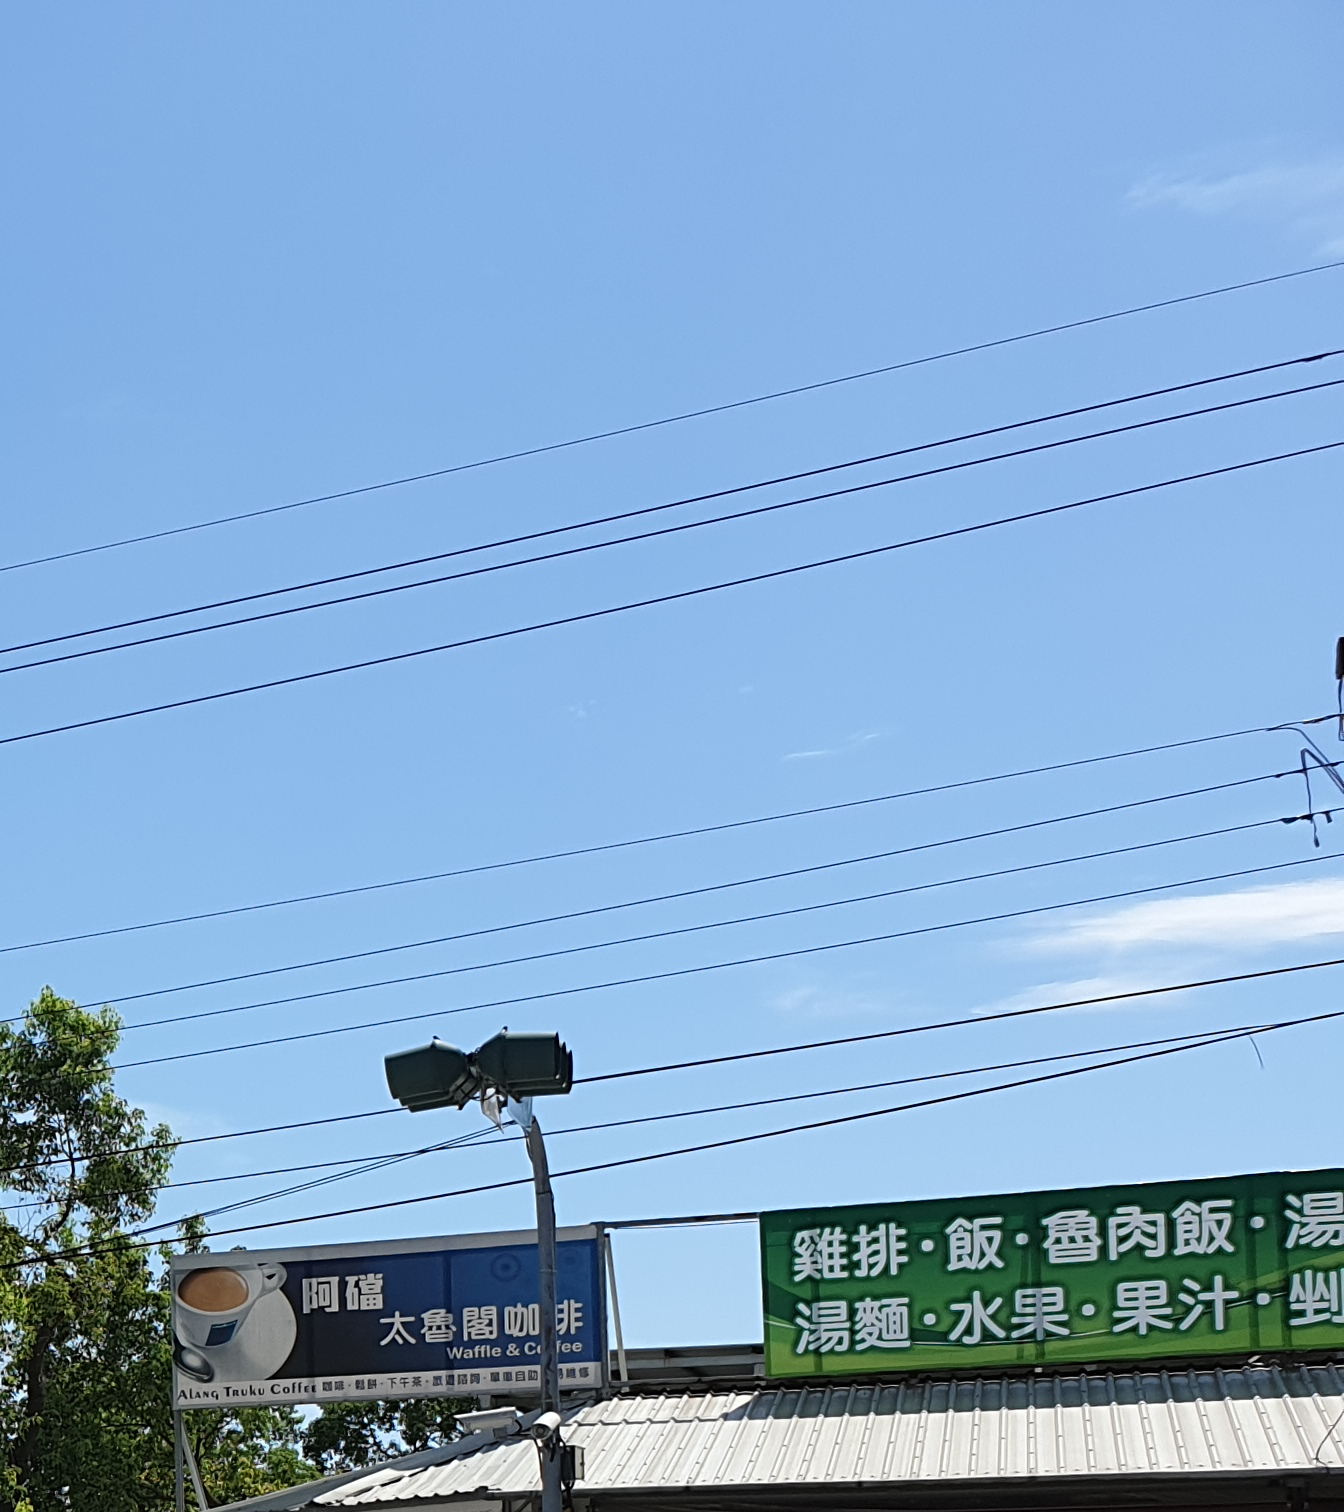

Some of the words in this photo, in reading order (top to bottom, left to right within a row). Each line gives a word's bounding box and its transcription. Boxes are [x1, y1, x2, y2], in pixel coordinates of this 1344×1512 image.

[302, 1273, 384, 1314] 阿礑
[446, 1345, 502, 1360] Waffle
[506, 1343, 520, 1357] &
[270, 1382, 317, 1395] Coffee
